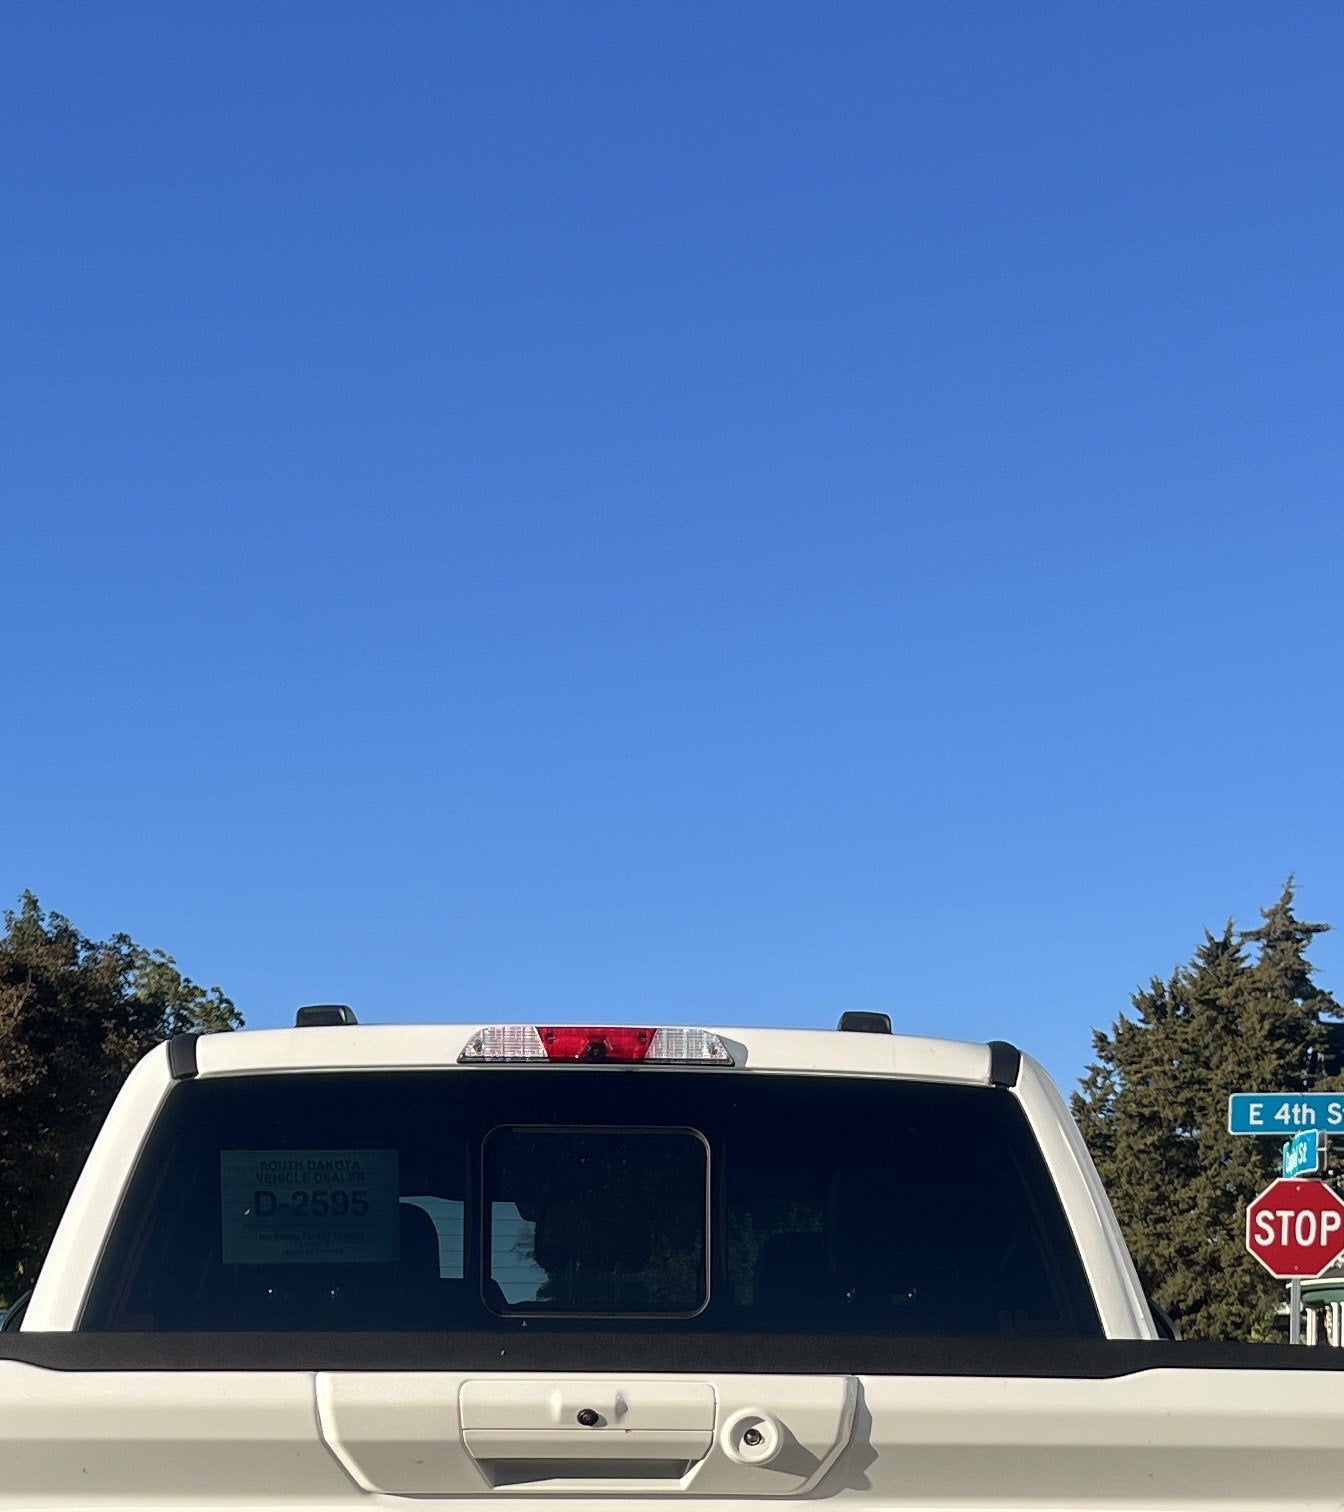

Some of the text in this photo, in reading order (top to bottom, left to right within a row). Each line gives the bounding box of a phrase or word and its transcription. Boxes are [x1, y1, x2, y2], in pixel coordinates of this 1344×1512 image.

[1249, 1103, 1264, 1125] E
[1274, 1103, 1316, 1125] 4th
[307, 1159, 362, 1171] DAKOTA
[254, 1190, 370, 1217] D-2595
[1254, 1210, 1342, 1247] STOP
